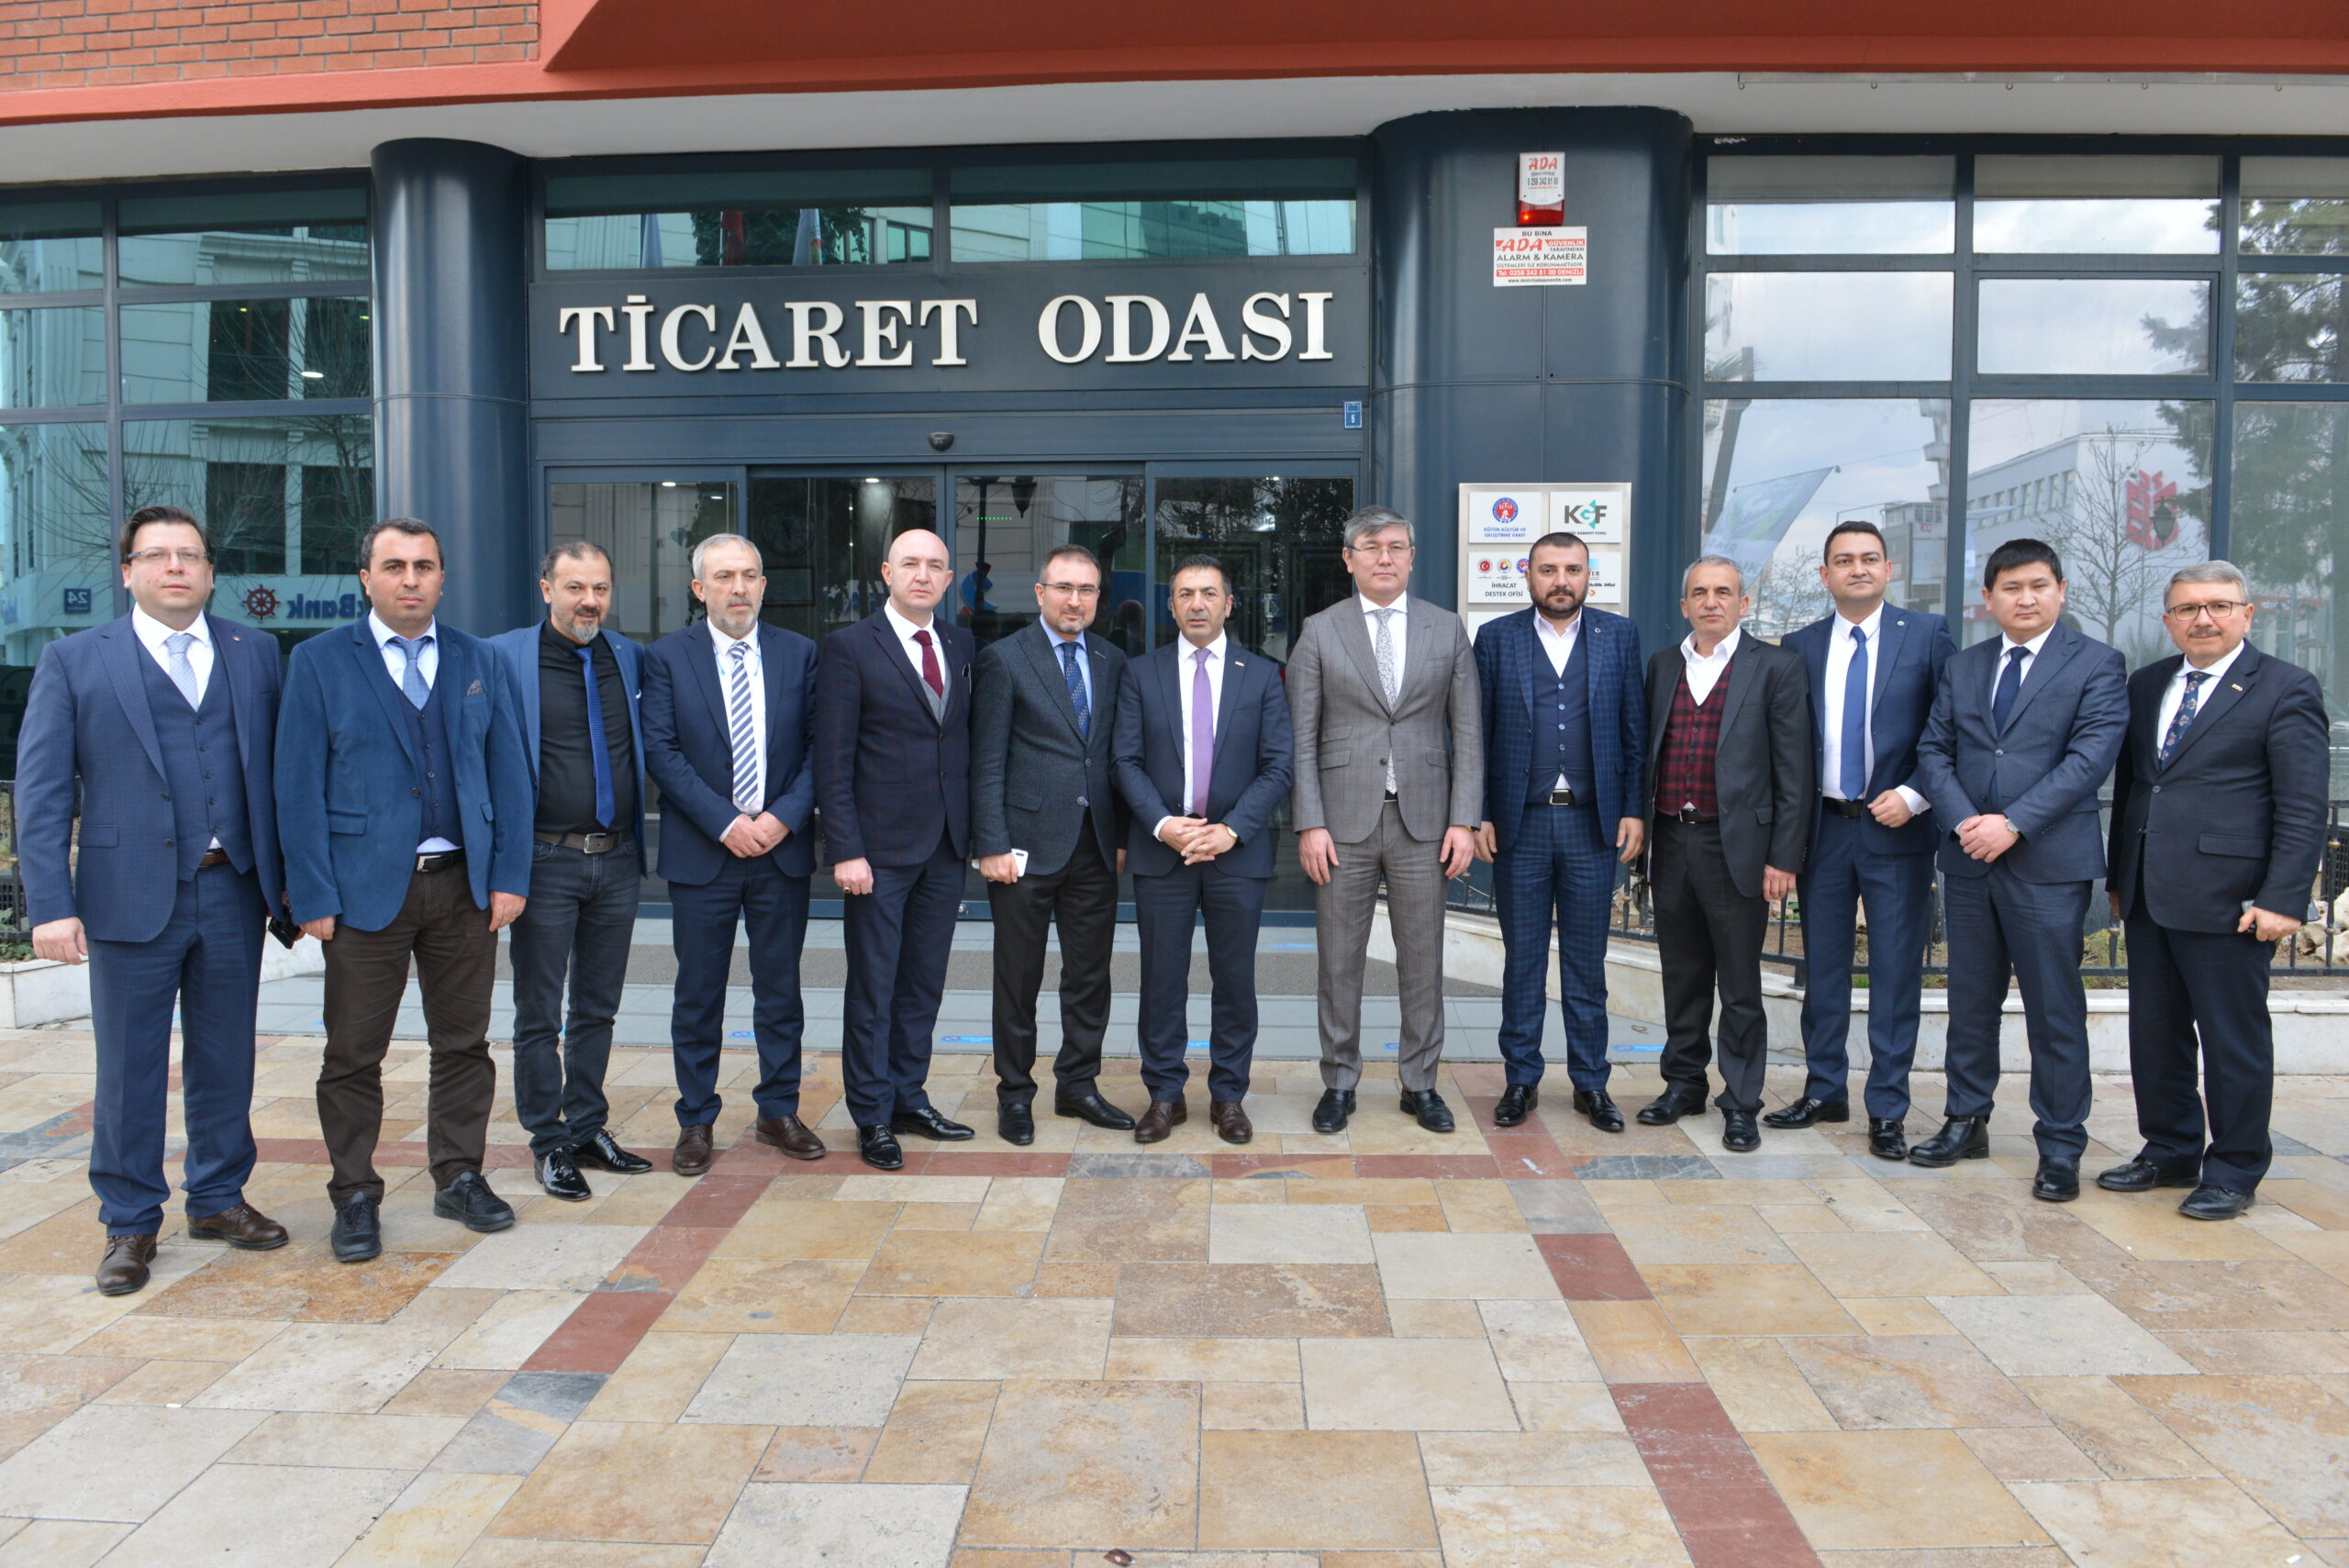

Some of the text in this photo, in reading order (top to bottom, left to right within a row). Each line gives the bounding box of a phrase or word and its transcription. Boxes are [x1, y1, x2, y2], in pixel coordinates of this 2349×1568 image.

[1529, 156, 1558, 171] ADA
[1501, 238, 1543, 252] ADA
[1497, 253, 1531, 261] ALARM
[1543, 252, 1584, 261] KAMERA
[559, 291, 1334, 373] TİCARET ODASI
[1564, 501, 1608, 528] KGF
